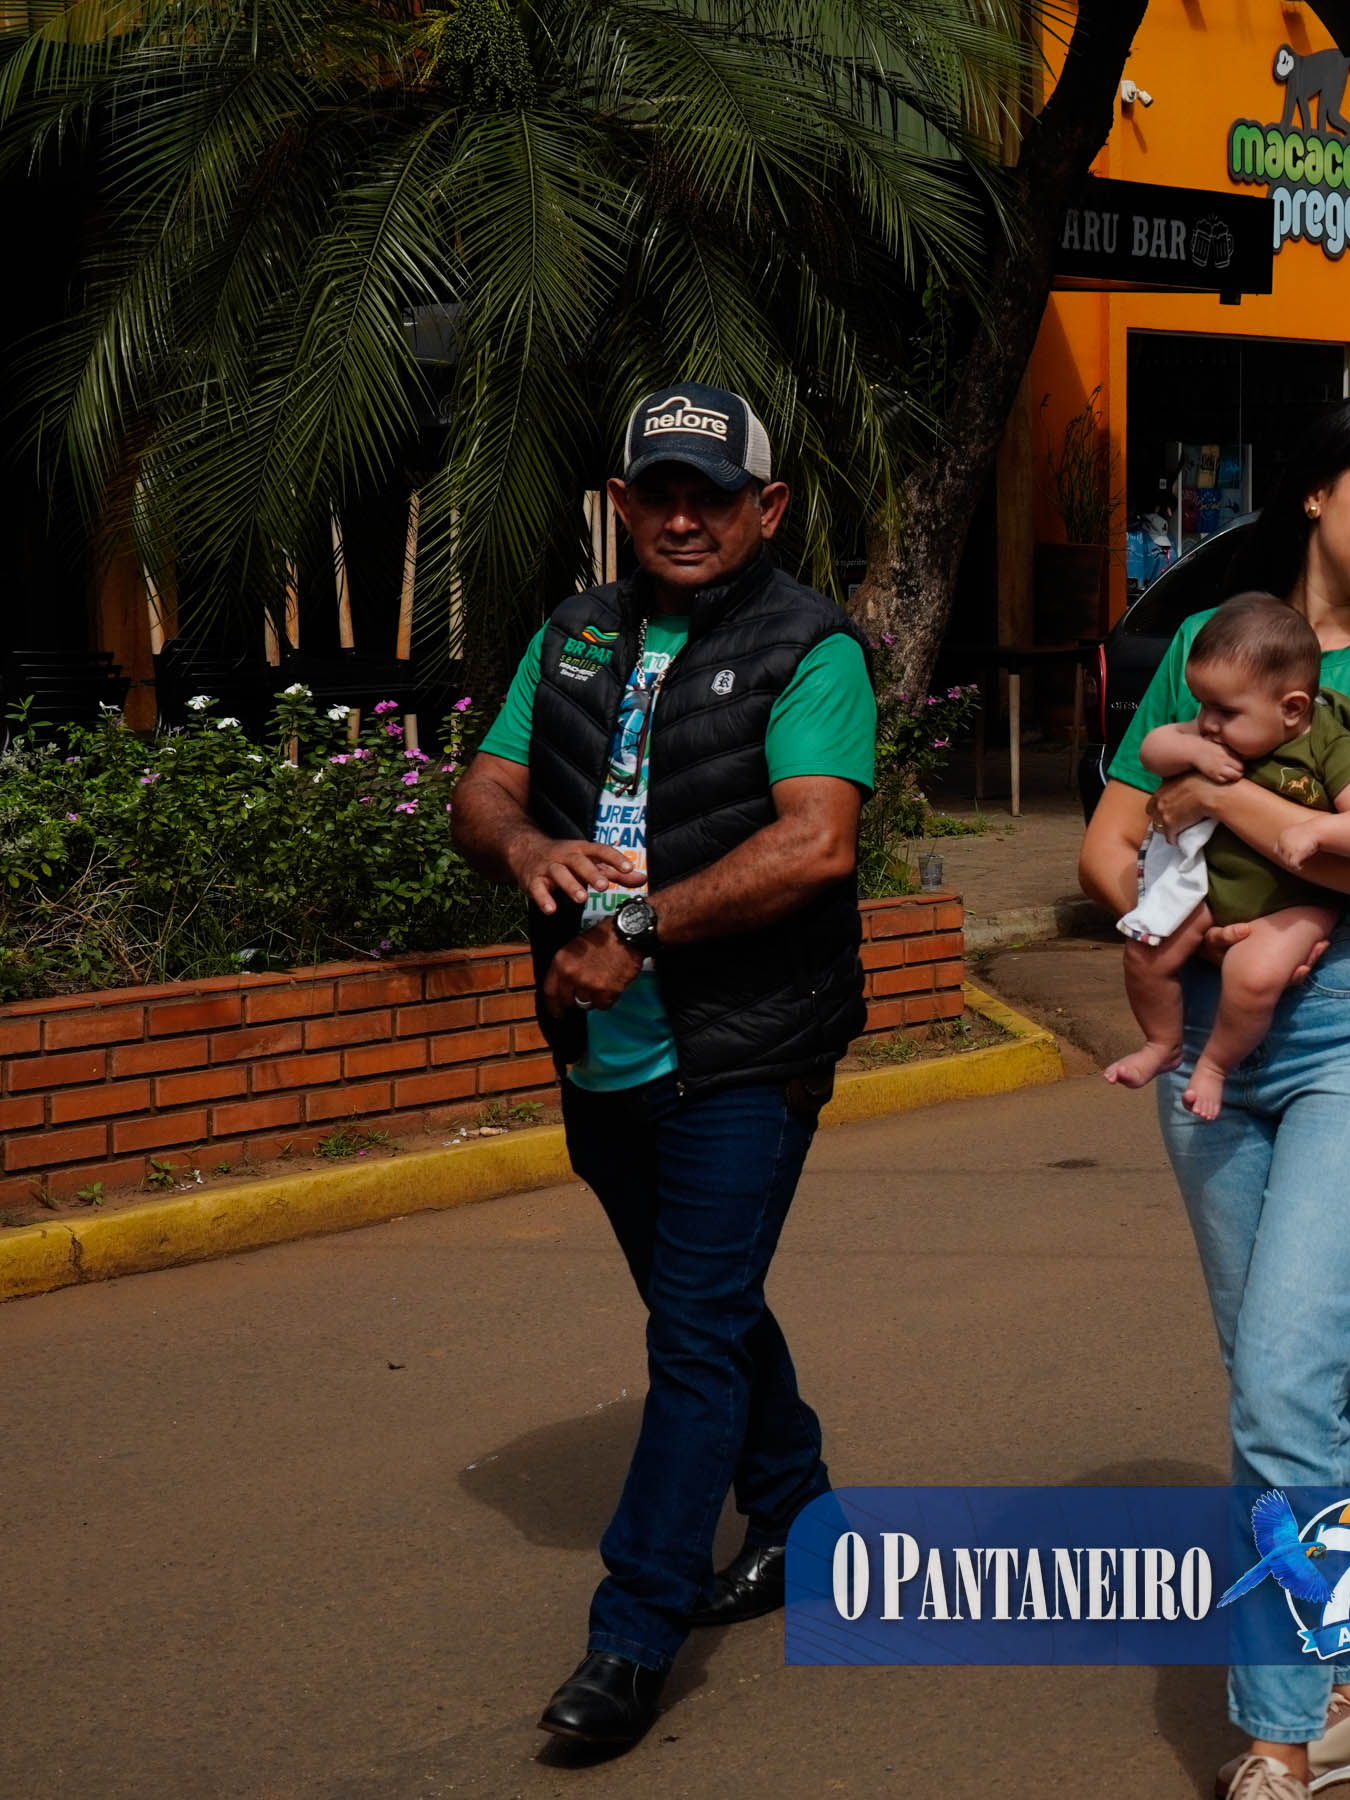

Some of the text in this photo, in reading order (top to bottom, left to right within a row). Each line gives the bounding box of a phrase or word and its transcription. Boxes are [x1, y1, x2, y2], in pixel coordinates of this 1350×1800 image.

[1058, 208, 1187, 261] ARU BAR
[645, 409, 728, 435] nelore
[563, 637, 587, 655] BR
